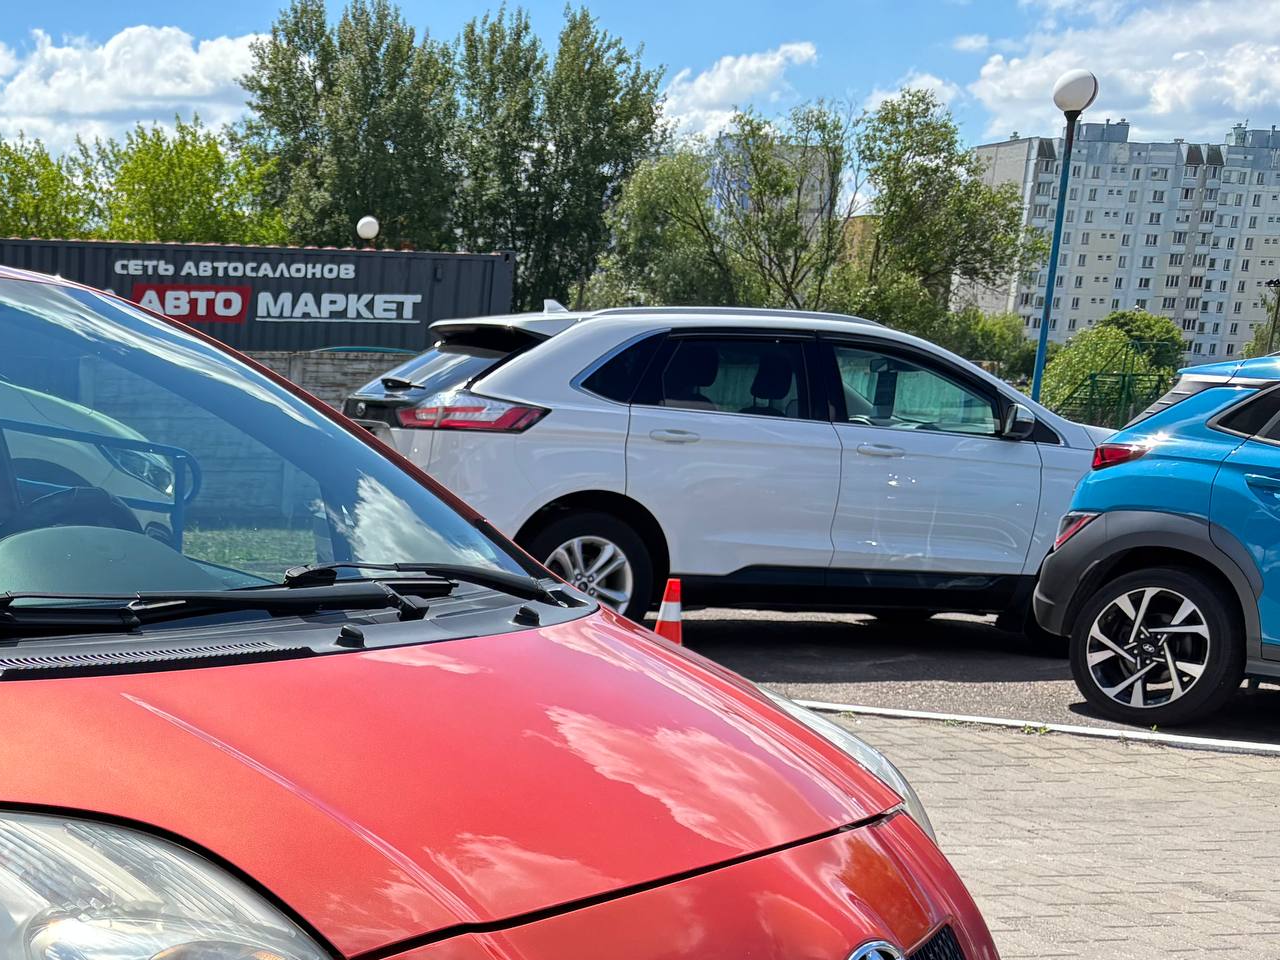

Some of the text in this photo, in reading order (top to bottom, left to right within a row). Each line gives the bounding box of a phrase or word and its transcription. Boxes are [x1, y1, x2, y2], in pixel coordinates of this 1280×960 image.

[114, 260, 356, 279] СЕТЬ АВТОСАЛОНОВ
[139, 289, 422, 319] АВТО МАРКЕТ
